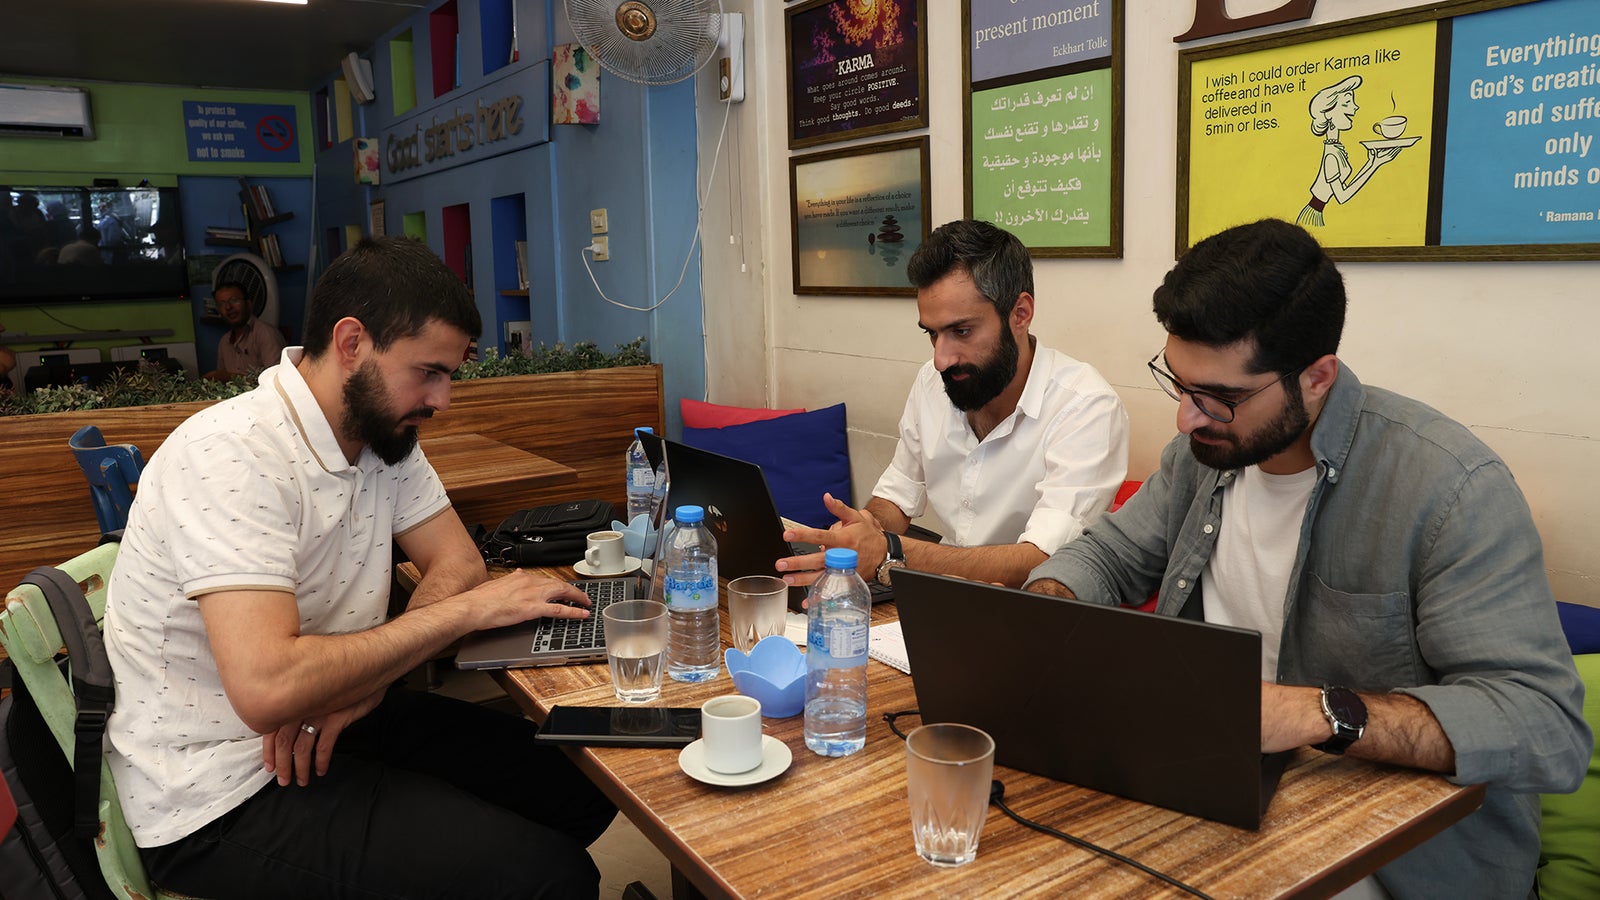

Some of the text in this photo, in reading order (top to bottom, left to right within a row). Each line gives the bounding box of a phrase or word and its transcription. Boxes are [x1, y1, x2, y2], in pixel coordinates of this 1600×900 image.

[975, 0, 1100, 49] present moment
[1053, 36, 1108, 57] Eckhart Tolle
[1486, 33, 1600, 67] Everything
[807, 64, 906, 94] What goes around comes around.
[1205, 48, 1401, 88] I wish I could order Karma like
[813, 78, 899, 104] Keep your circle POSITIVE.
[991, 84, 1094, 112] إن لم تعرف قدراتك
[1264, 81, 1295, 95] have
[1298, 78, 1306, 91] it
[1470, 74, 1524, 100] God's
[197, 105, 236, 115] To protect the
[830, 94, 880, 111] Say good words.
[1205, 100, 1271, 120] delivered in
[188, 119, 208, 128] quality
[209, 119, 215, 127] of
[800, 119, 814, 128] Think
[817, 116, 830, 125] good
[832, 111, 861, 121] thoughts.
[864, 107, 872, 115] Do
[874, 103, 890, 114] good
[1206, 117, 1280, 136] 5min or less.
[1505, 103, 1543, 127] and
[213, 132, 223, 141] ask
[224, 133, 234, 142] you
[387, 95, 524, 173] Good starts here
[984, 116, 1099, 142] و تقدرها و تقنع نفسك
[196, 147, 245, 158] not to smoke
[982, 142, 1102, 171] بأنها موجودة و حقيقية
[1545, 132, 1593, 158] only
[1004, 177, 1082, 199] فكيف تتوقع أن
[1514, 165, 1579, 188] minds
[863, 193, 884, 202] reflection
[895, 190, 912, 199] choice
[1051, 208, 1090, 225] يقدرك
[1546, 211, 1593, 222] Ramana
